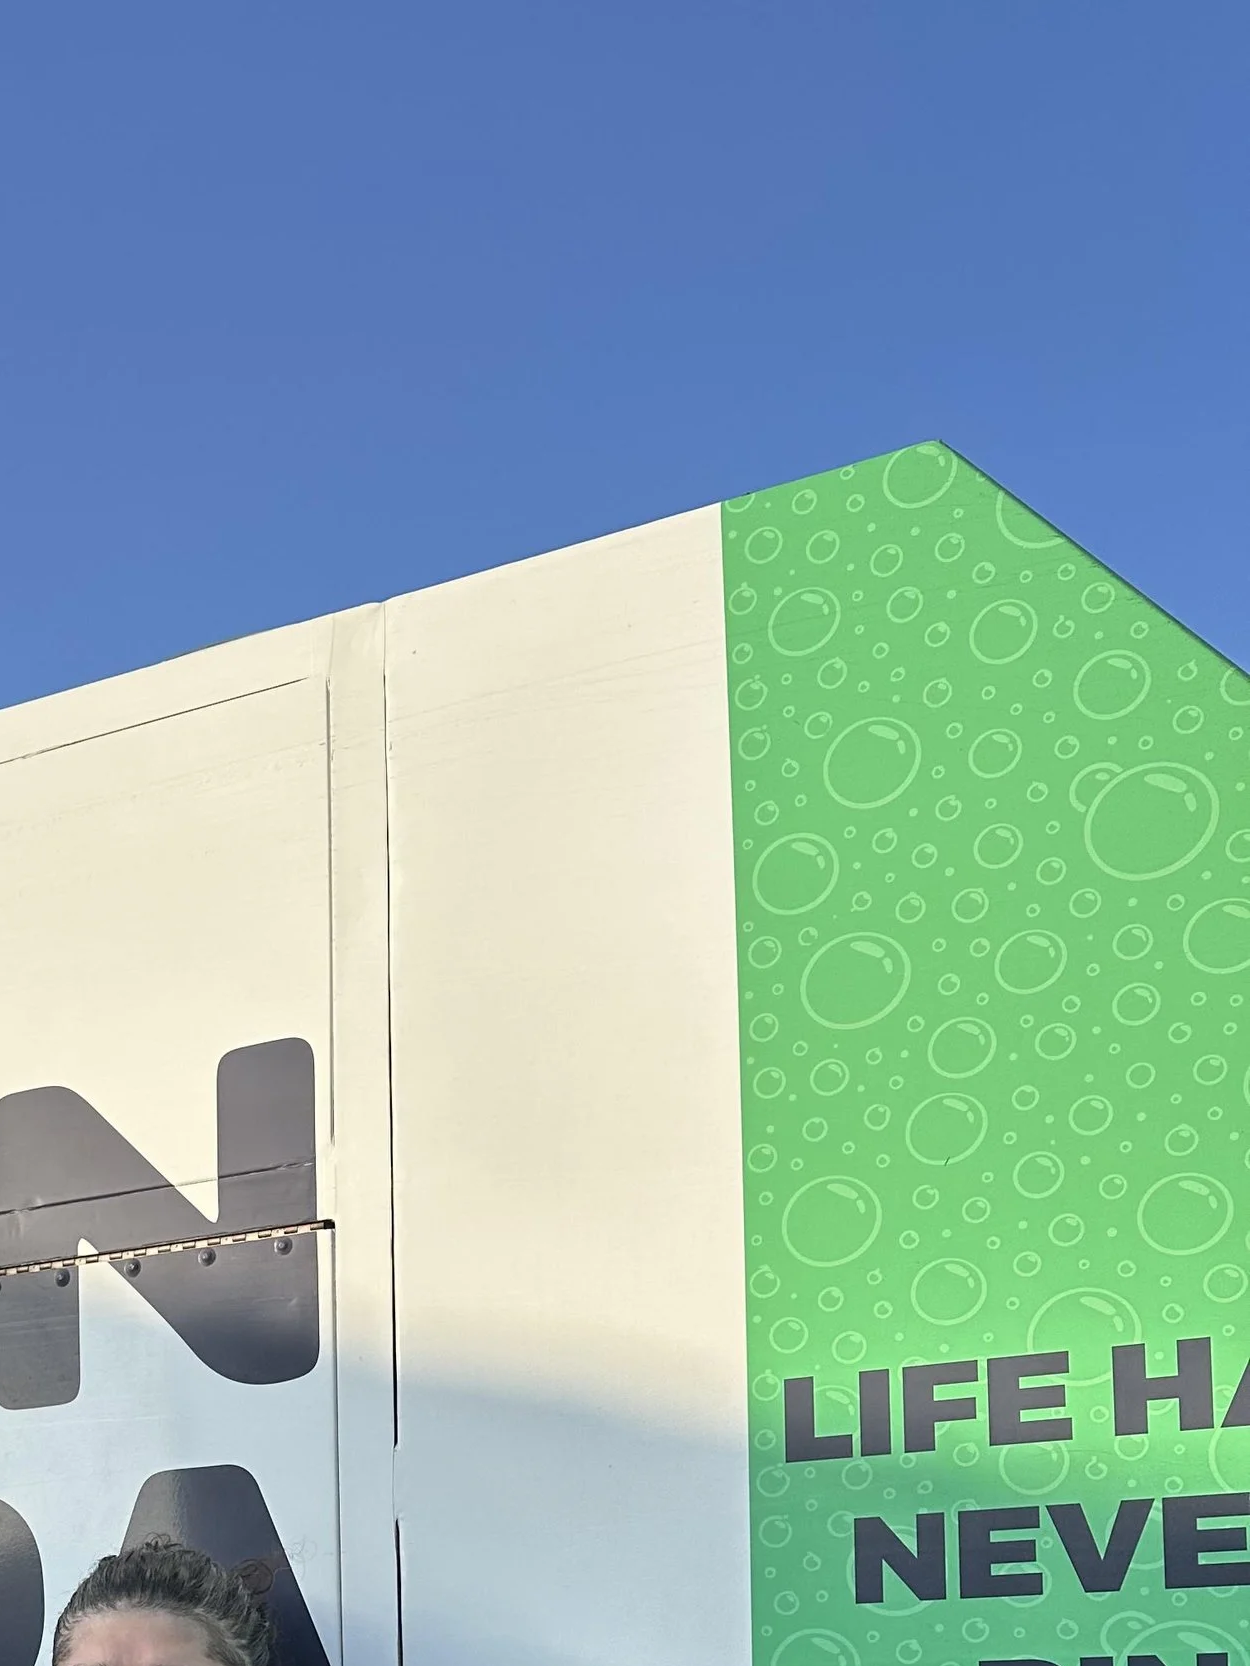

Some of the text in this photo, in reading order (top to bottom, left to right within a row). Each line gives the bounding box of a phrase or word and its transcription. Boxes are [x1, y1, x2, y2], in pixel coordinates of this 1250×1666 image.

[784, 1336, 1250, 1463] LIFE H
[853, 1491, 1250, 1605] NEVE
